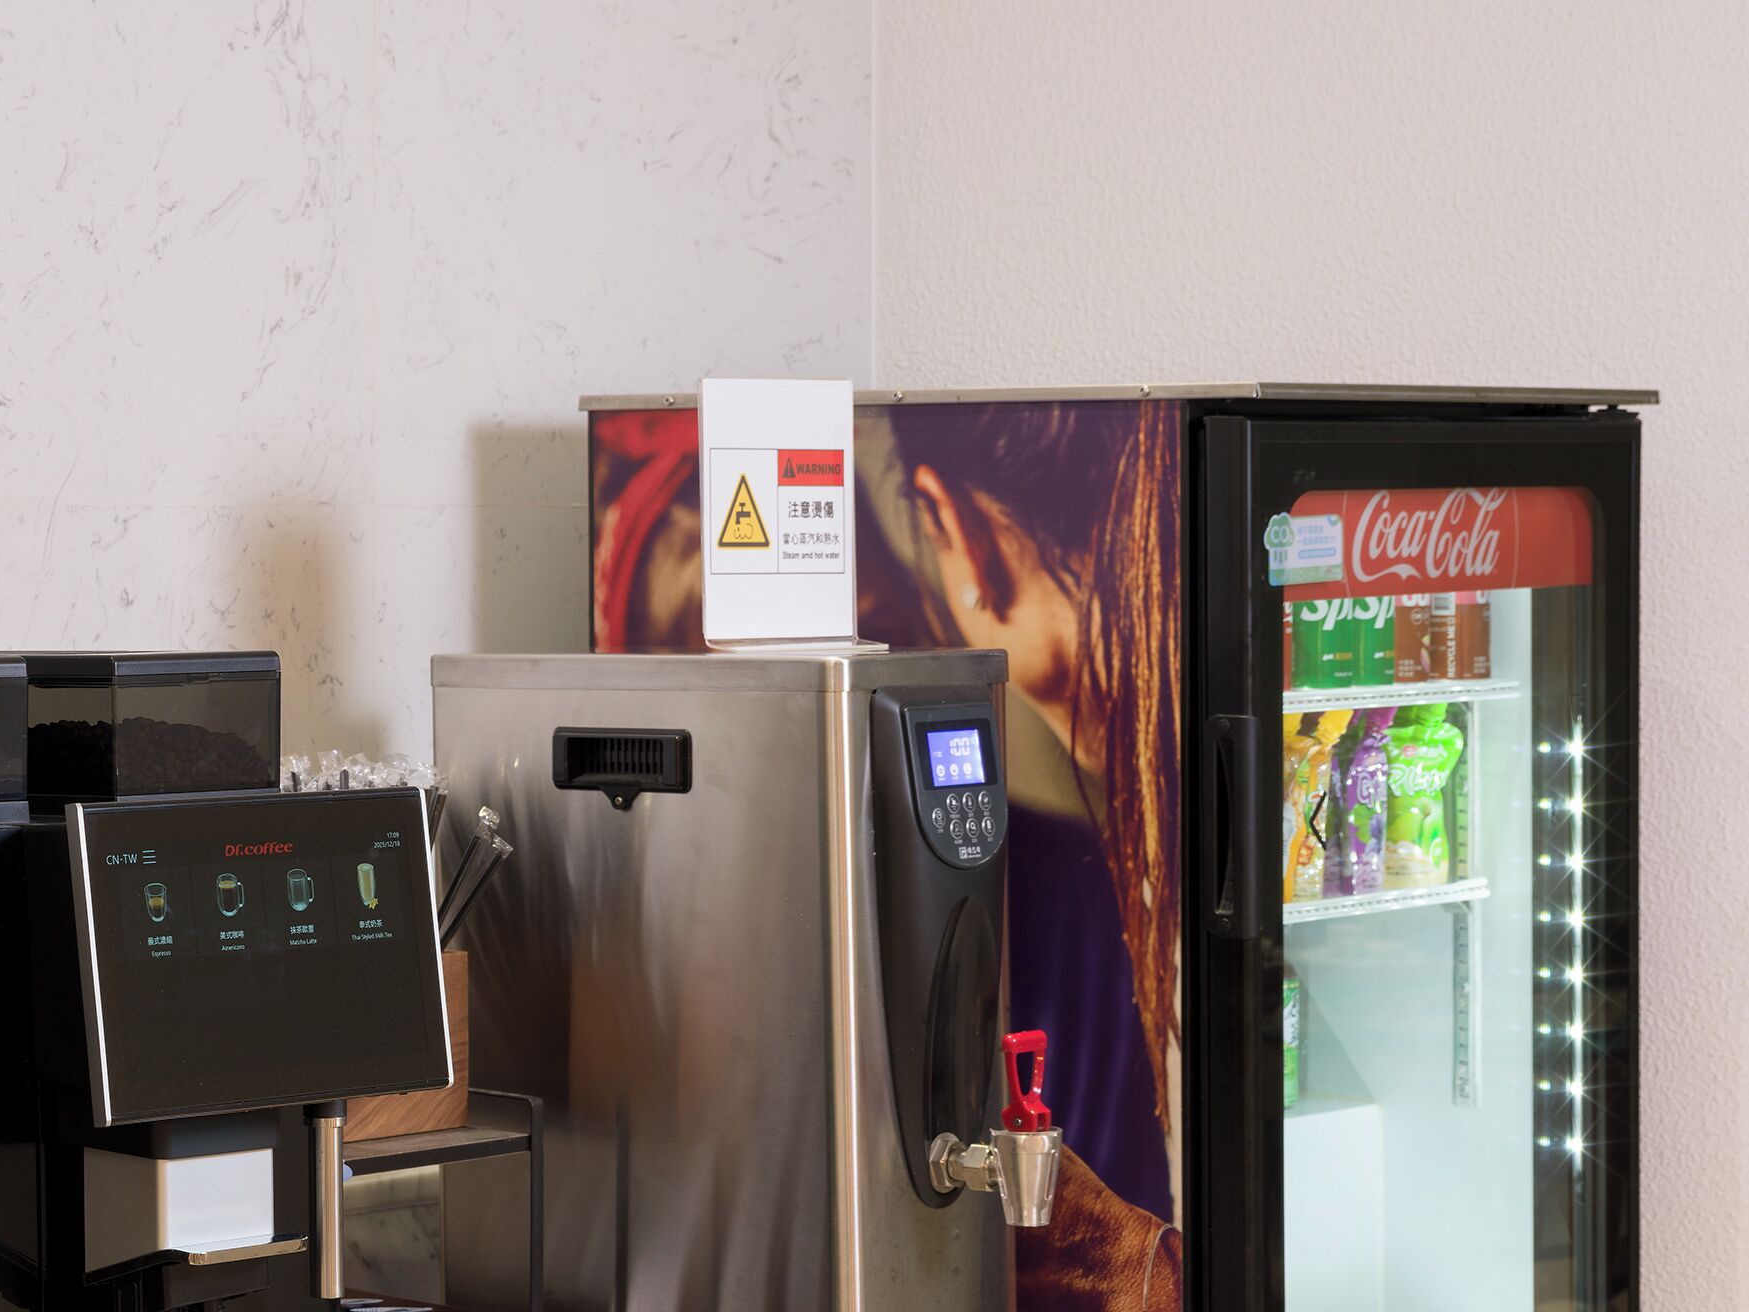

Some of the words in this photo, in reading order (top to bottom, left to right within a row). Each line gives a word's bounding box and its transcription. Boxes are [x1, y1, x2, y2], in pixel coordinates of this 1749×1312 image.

[796, 463, 841, 476] WARNING
[788, 501, 834, 519] 注意燙傷
[815, 551, 824, 559] hot
[225, 841, 294, 857] Dr.coffee
[106, 854, 138, 866] CN-TW
[152, 950, 172, 958] Espresso
